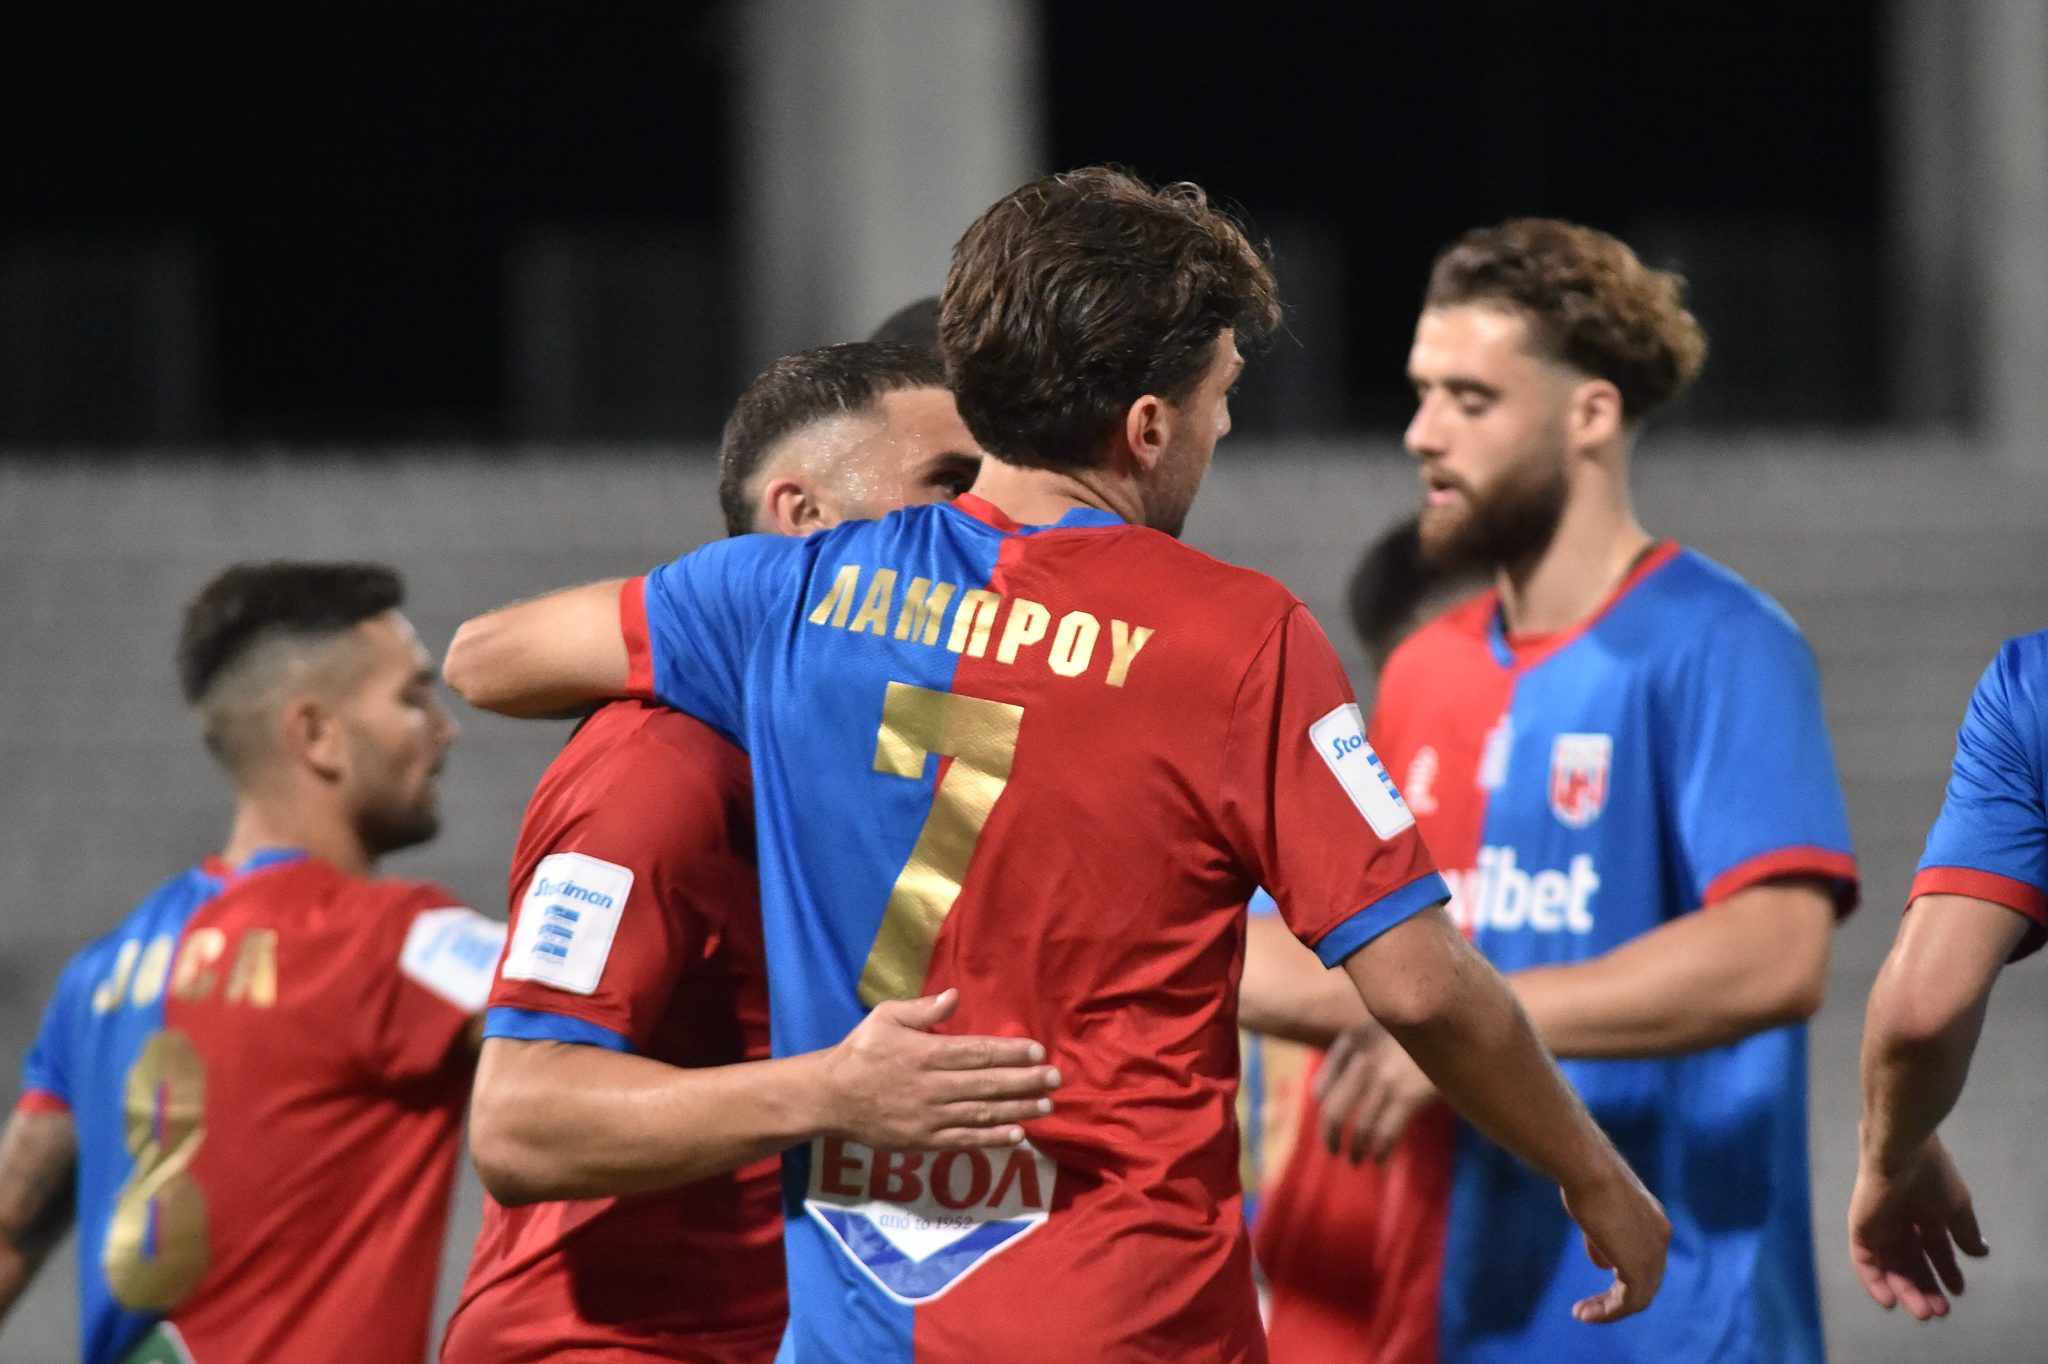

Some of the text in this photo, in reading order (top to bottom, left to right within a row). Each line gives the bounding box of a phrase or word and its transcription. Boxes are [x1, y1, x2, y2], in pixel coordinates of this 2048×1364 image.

[807, 564, 1155, 689] ΛΑΜΠΡΟΥ
[857, 680, 1025, 1009] 7
[104, 1029, 210, 1310] 8
